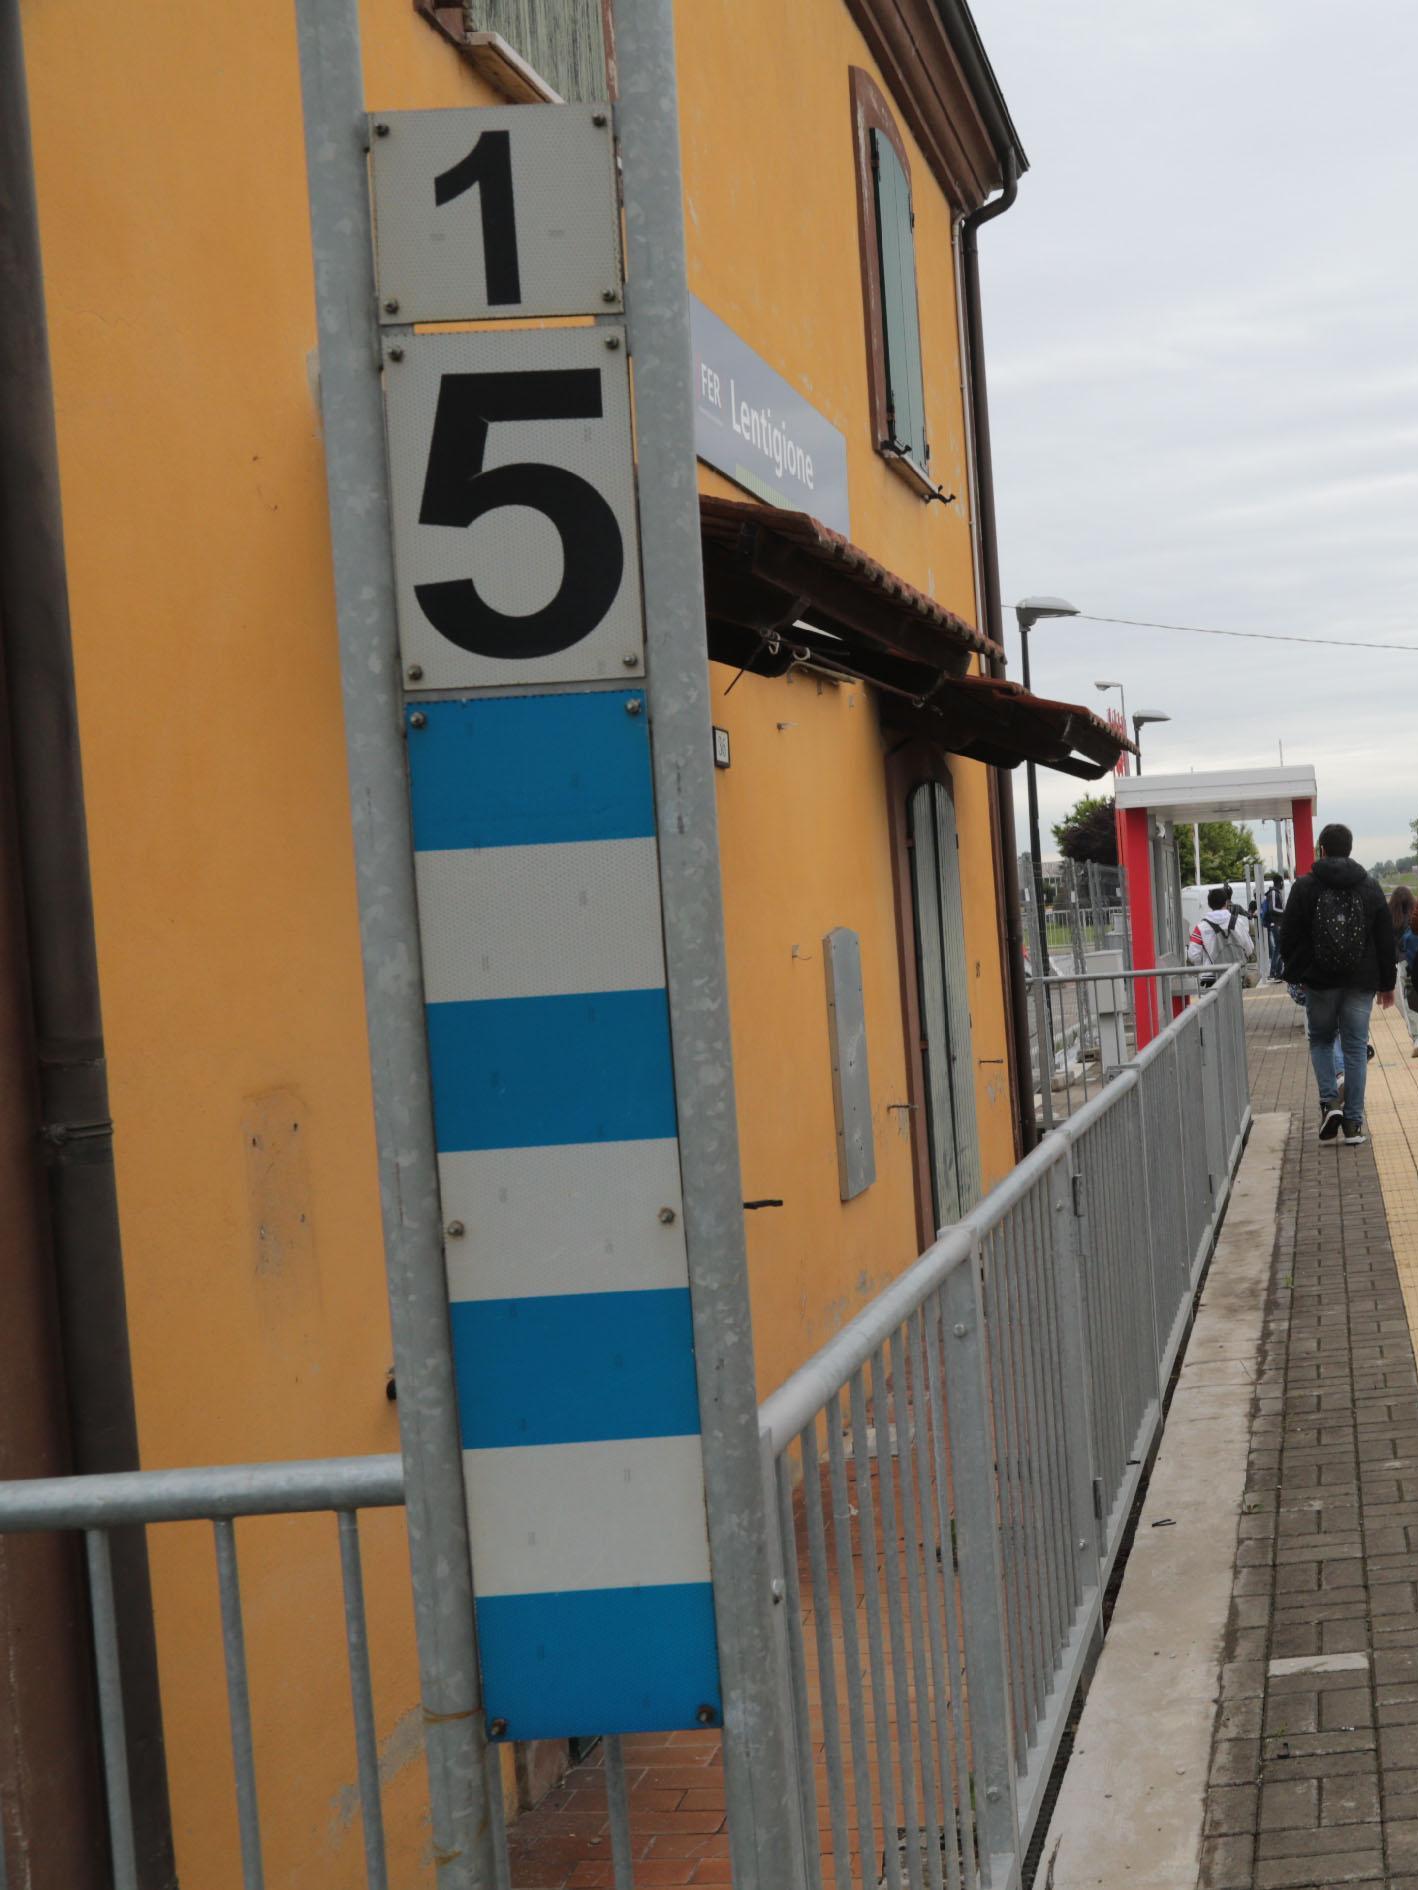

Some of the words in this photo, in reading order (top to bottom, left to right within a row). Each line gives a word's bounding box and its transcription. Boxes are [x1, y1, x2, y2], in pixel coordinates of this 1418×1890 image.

[414, 368, 624, 660] 5
[701, 362, 722, 409] FER
[730, 378, 815, 490] Lentigione
